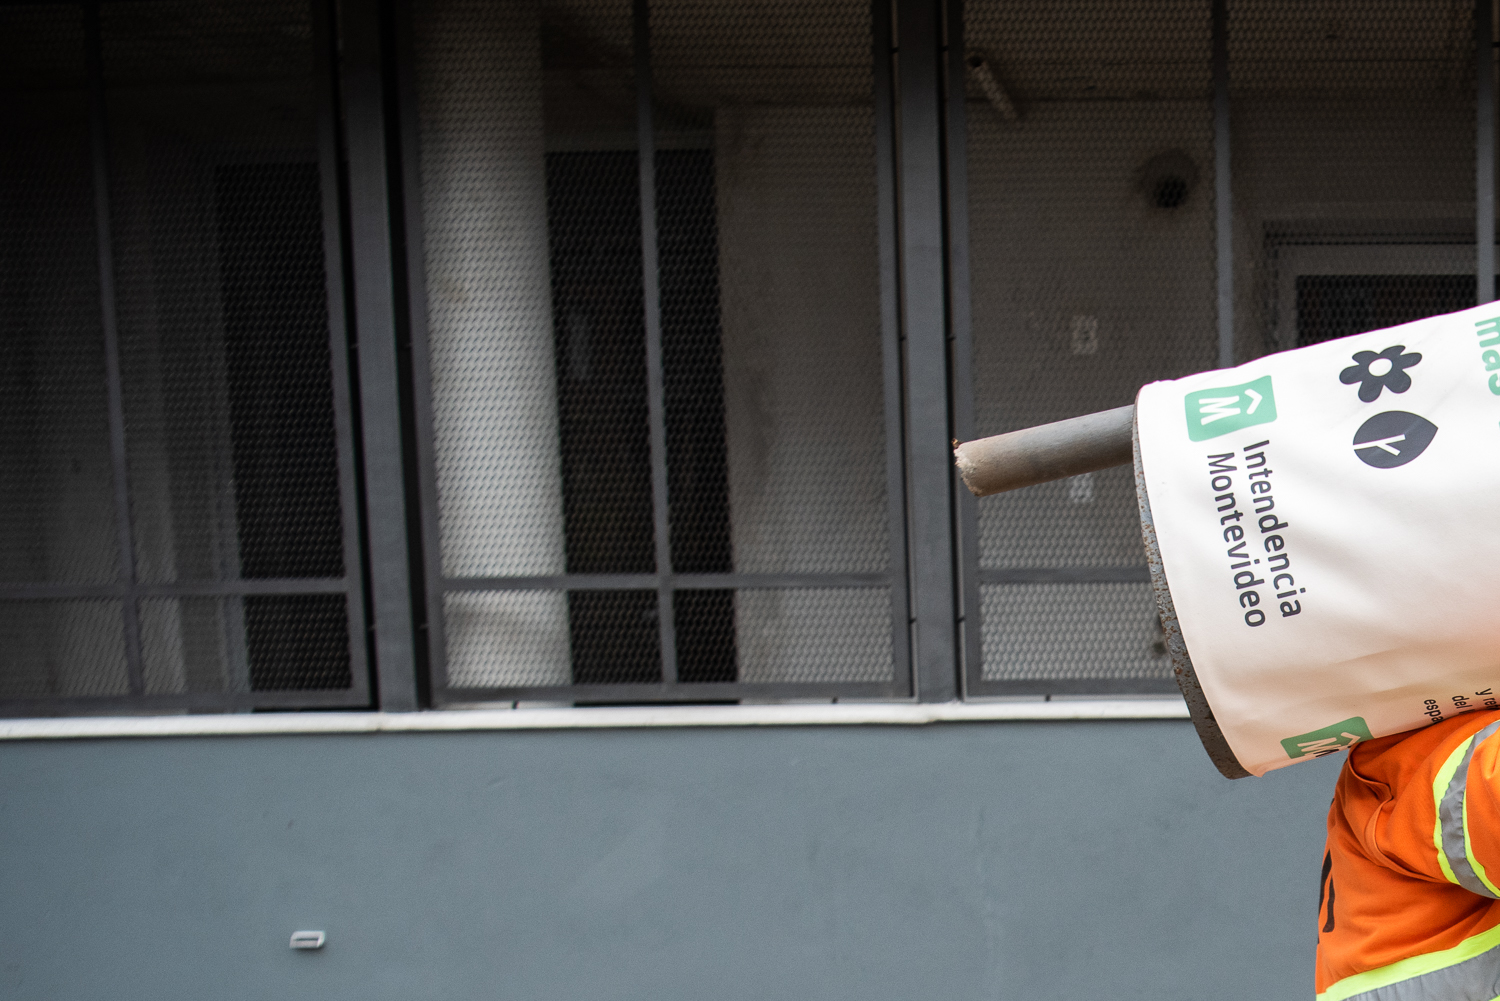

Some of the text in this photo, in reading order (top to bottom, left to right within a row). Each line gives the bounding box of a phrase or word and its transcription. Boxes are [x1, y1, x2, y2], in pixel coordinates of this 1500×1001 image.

[1206, 452, 1267, 628] Montevideo
[1243, 439, 1307, 618] Intendencia
[1452, 695, 1474, 709] del
[1475, 687, 1493, 696] y
